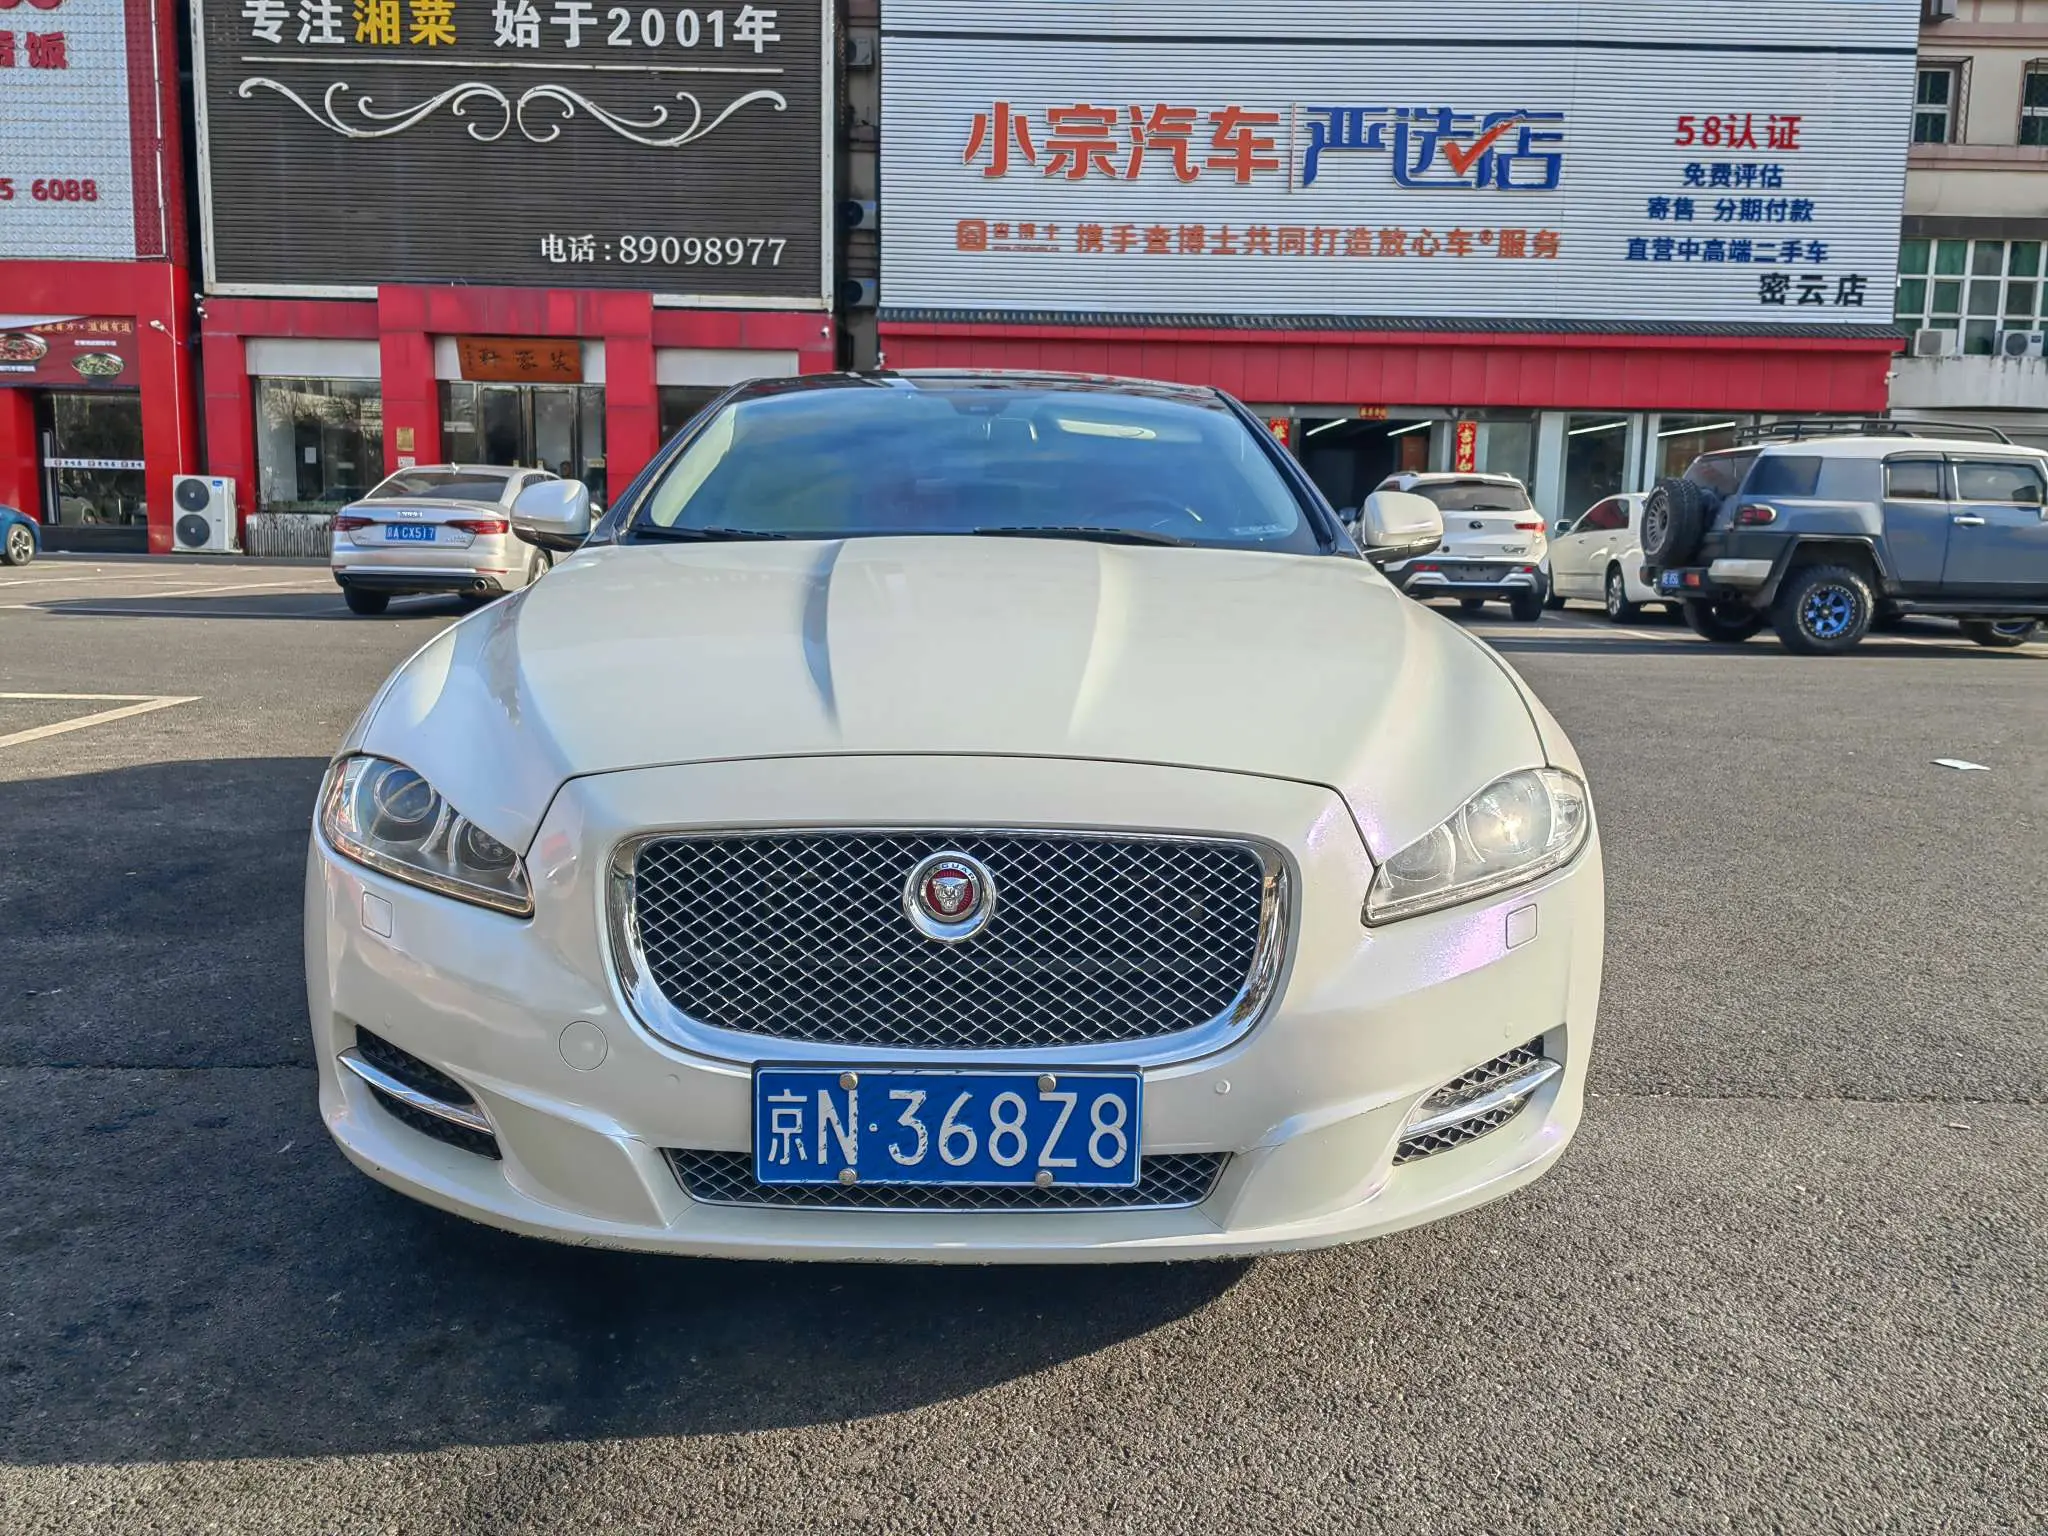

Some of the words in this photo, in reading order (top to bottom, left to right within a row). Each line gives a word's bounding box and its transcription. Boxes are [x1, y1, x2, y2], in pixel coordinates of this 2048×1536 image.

[241, 0, 457, 45] 专注湘菜
[494, 5, 781, 53] 始于2001年
[1674, 113, 1802, 149] 58认证
[963, 101, 1280, 185] 小宗汽车
[1302, 106, 1565, 192] 严选店
[32, 179, 97, 201] 6088
[1682, 163, 1784, 188] 免费评估
[1647, 197, 1694, 221] 寄售
[1713, 198, 1814, 222] 分期付款
[1625, 237, 1829, 264] 直营中高端二手车
[1758, 273, 1867, 306] 密云店
